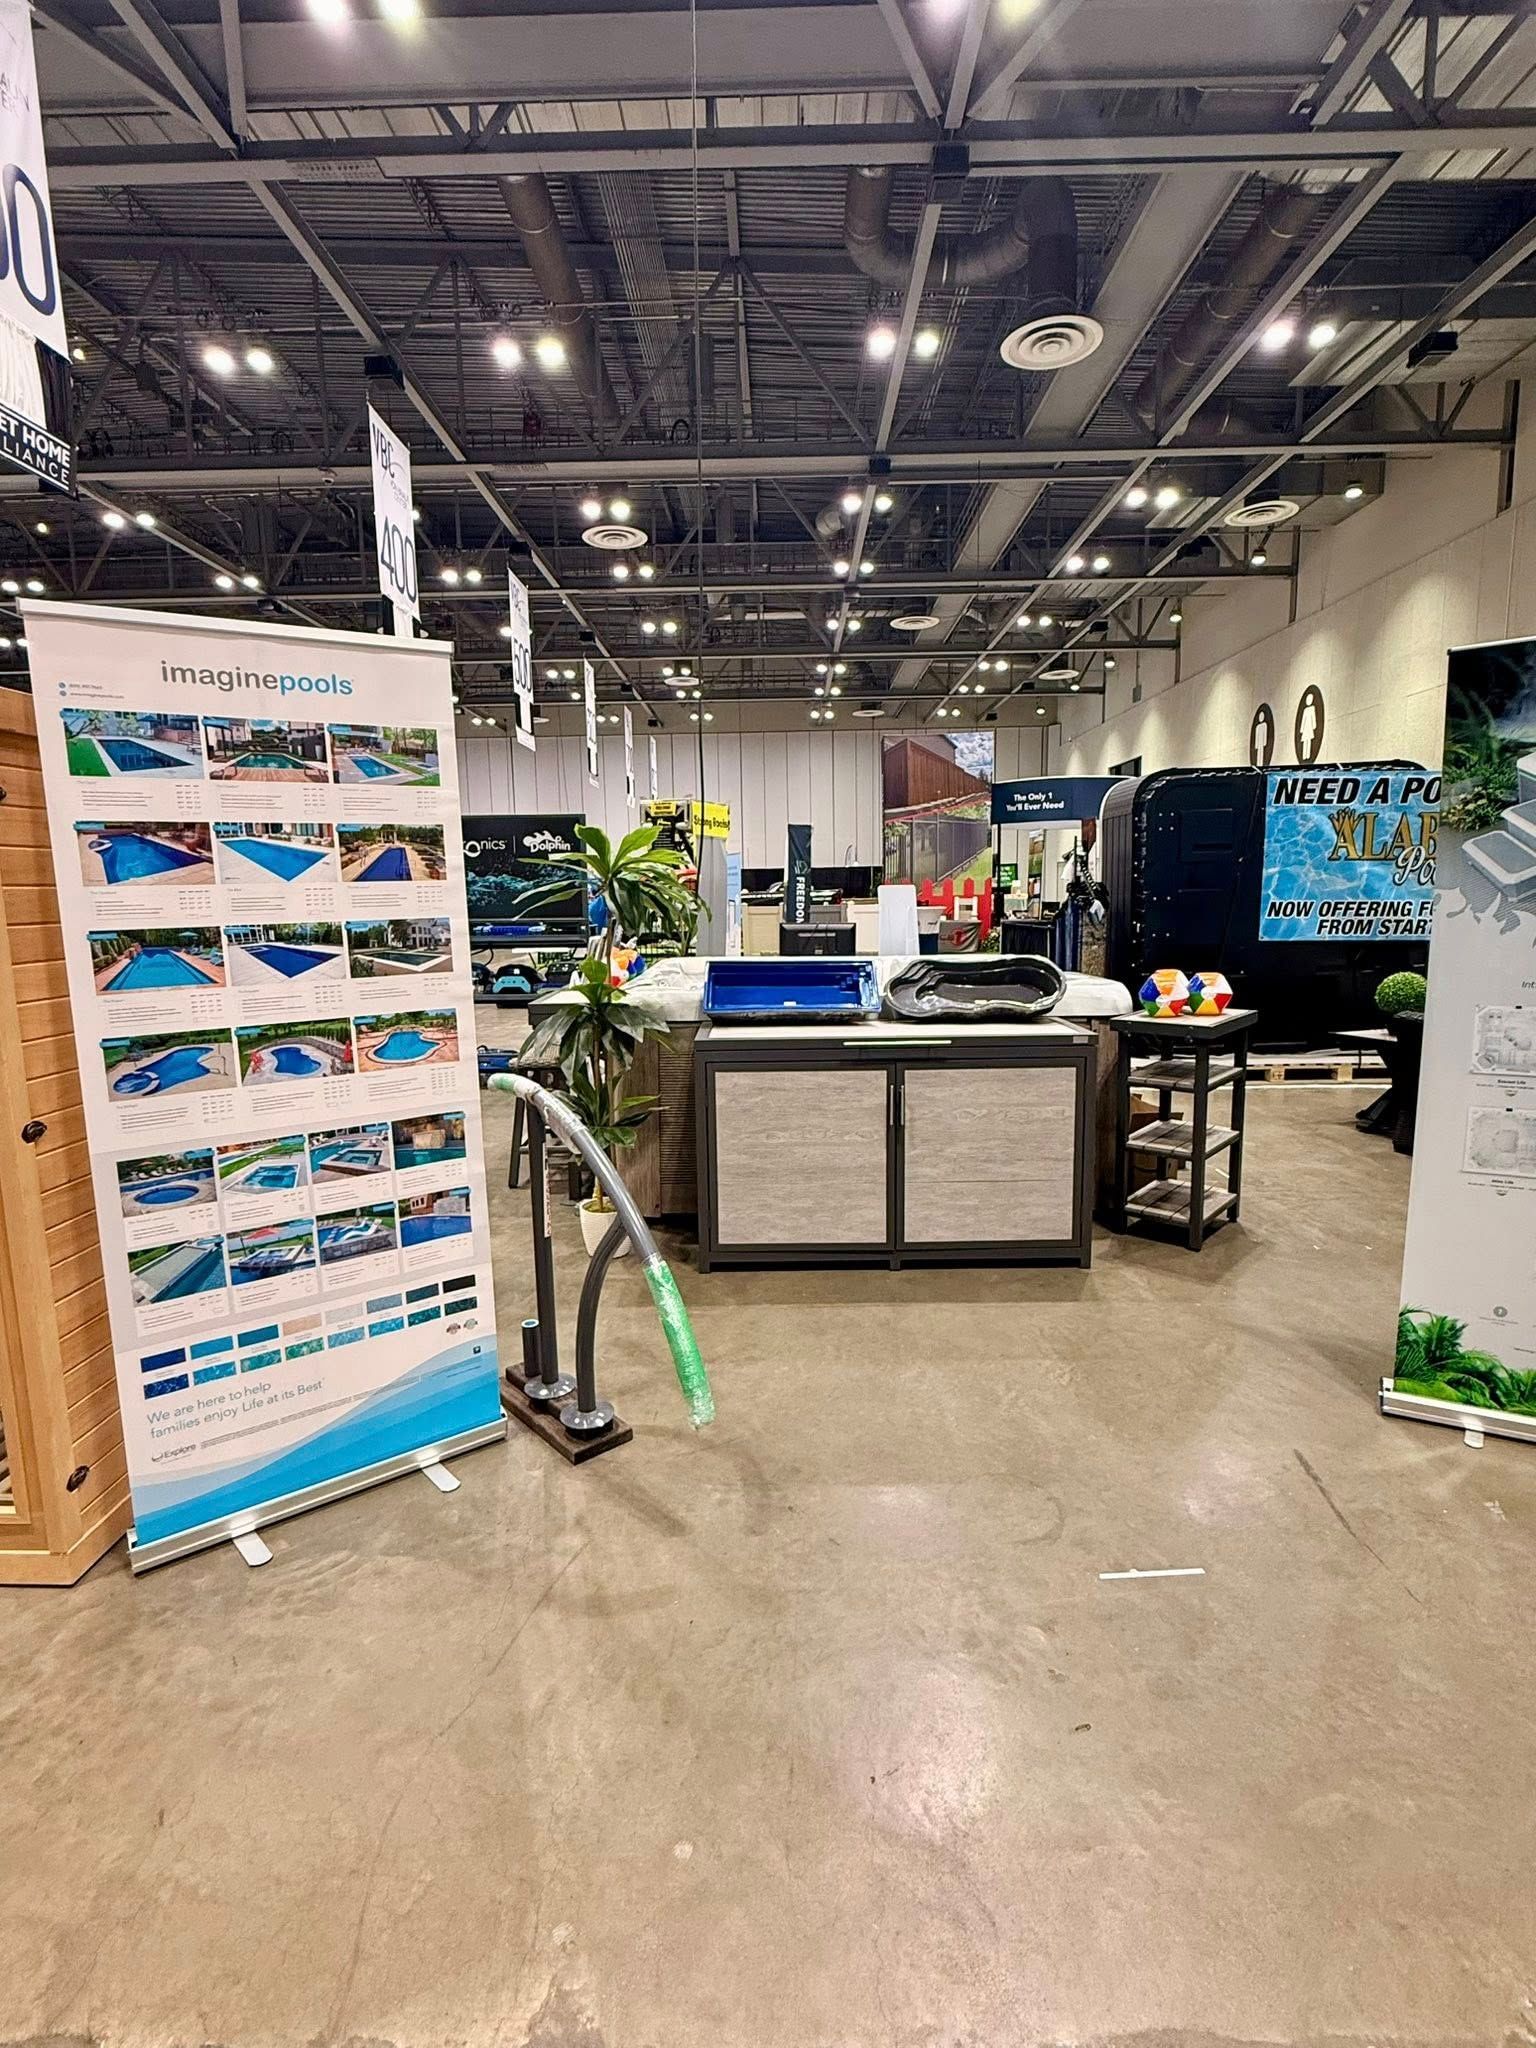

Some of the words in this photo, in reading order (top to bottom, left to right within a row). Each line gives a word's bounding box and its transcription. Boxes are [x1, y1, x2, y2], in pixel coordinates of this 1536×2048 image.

[22, 425, 71, 468] HOME
[372, 422, 395, 479] VBC
[381, 516, 417, 604] 400
[160, 660, 353, 695] imaginepools
[514, 639, 532, 693] 500
[1006, 802, 1023, 811] You'll
[1024, 802, 1041, 811] Ever
[1042, 800, 1065, 810] Need
[1013, 793, 1027, 802] The
[1028, 792, 1046, 802] Only
[1048, 792, 1053, 800] 1
[1273, 777, 1361, 805] NEED
[1366, 777, 1390, 805] A
[530, 837, 571, 853] Dolphin
[1267, 901, 1314, 917] NOW
[1318, 901, 1413, 917] OFFERING
[1316, 919, 1373, 935] FROM
[147, 1411, 171, 1425] We
[174, 1405, 194, 1418] are
[197, 1393, 226, 1411] here
[229, 1389, 243, 1402] to
[244, 1381, 272, 1398] help
[150, 1418, 201, 1439] families
[203, 1406, 238, 1424] enjoy
[242, 1397, 264, 1412] Life
[266, 1394, 279, 1406] at
[281, 1389, 295, 1401] its
[297, 1381, 323, 1396] Best
